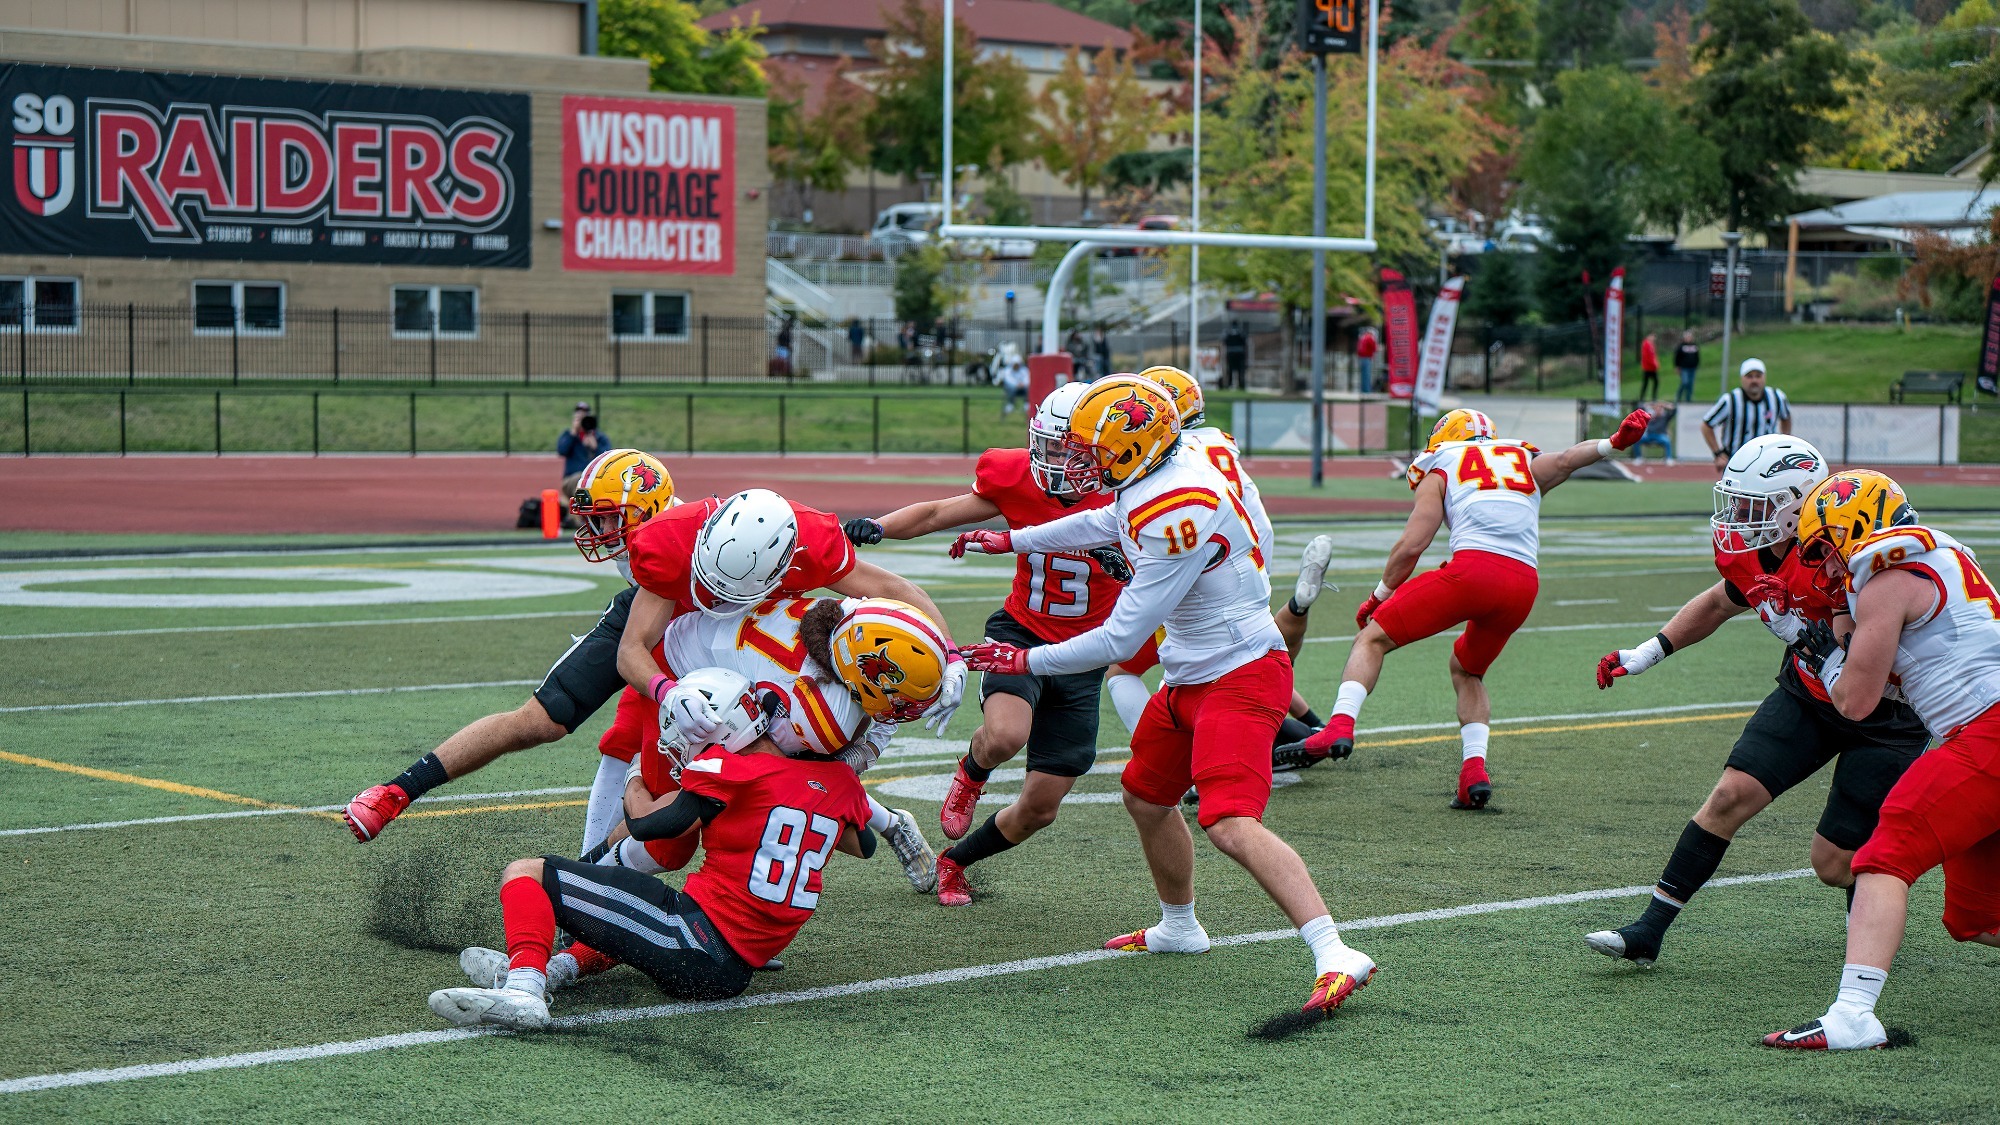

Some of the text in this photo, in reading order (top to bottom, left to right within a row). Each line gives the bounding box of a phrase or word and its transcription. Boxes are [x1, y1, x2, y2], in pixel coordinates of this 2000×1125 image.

[12, 92, 75, 135] SO
[576, 110, 721, 169] WISDOM
[13, 146, 75, 216] U
[95, 107, 508, 231] RAIDERS
[577, 167, 720, 219] COURAGE
[206, 225, 253, 243] STUDENTS
[575, 217, 721, 262] CHARACTER
[1422, 315, 1450, 390] RAIDERS
[1456, 445, 1537, 497] 43
[1163, 518, 1198, 556] 18
[1027, 552, 1091, 618] 13
[748, 805, 840, 910] 82
